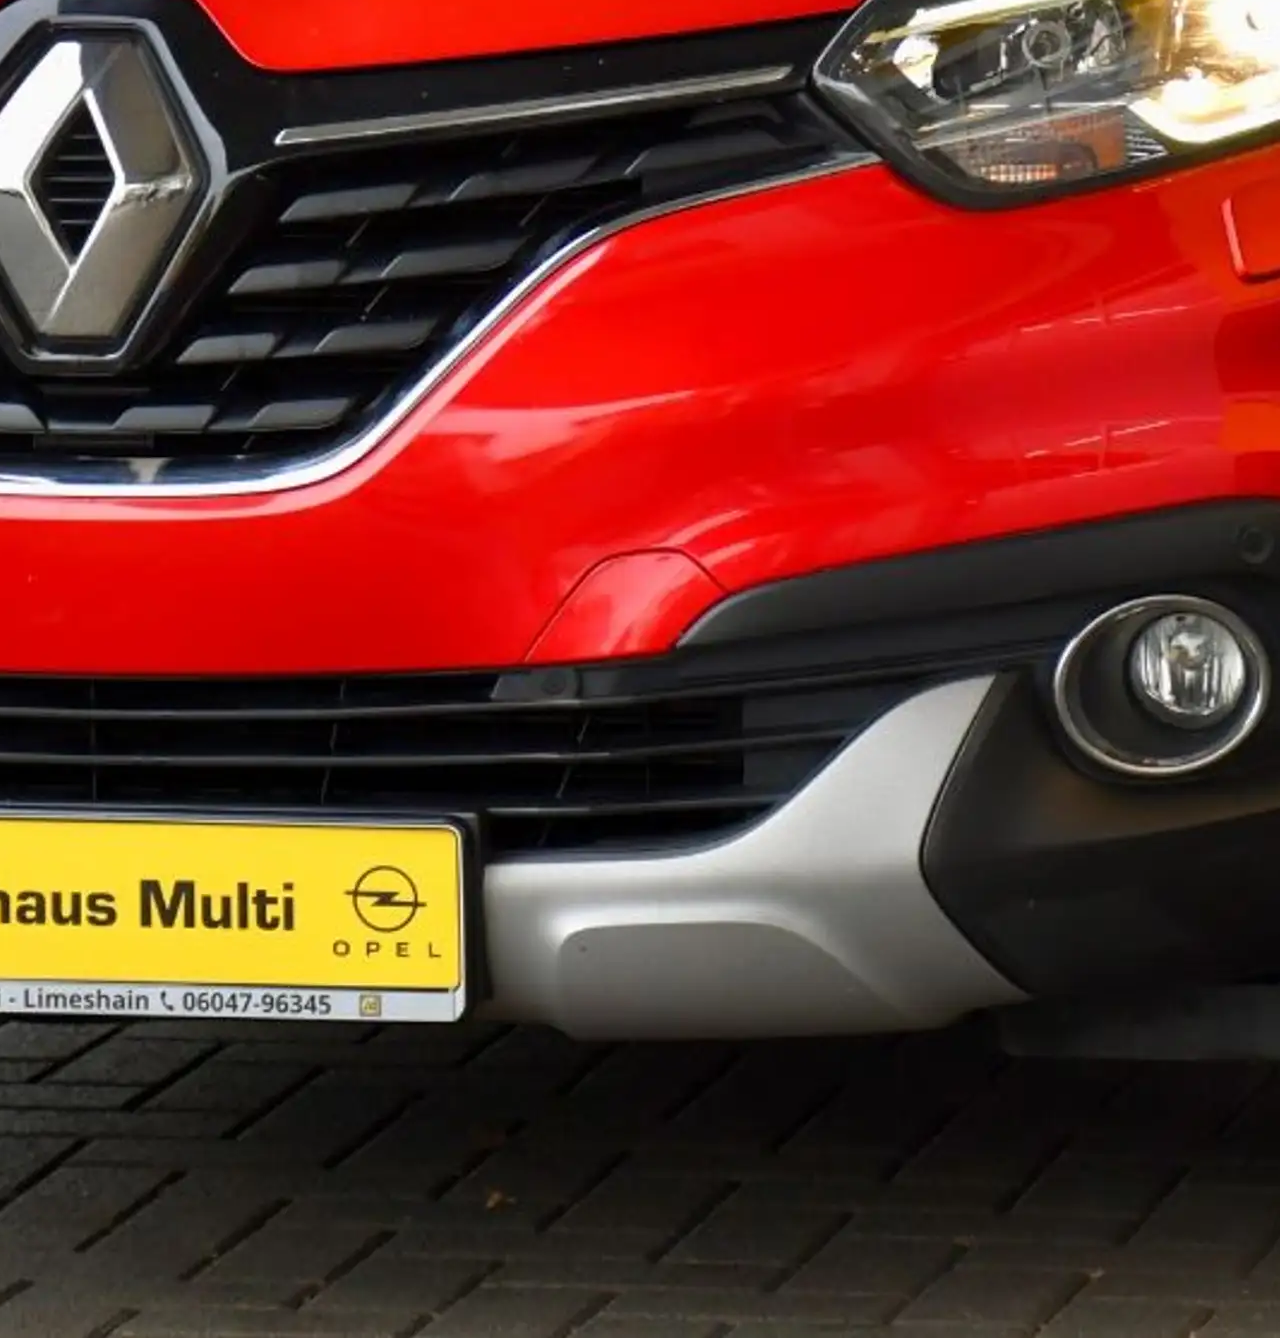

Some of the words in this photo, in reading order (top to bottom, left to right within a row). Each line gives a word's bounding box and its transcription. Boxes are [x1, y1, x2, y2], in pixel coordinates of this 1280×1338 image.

[140, 879, 294, 931] Multi
[332, 939, 442, 958] OPEL
[23, 987, 150, 1010] Limeshain
[182, 991, 332, 1015] 06047-96345
